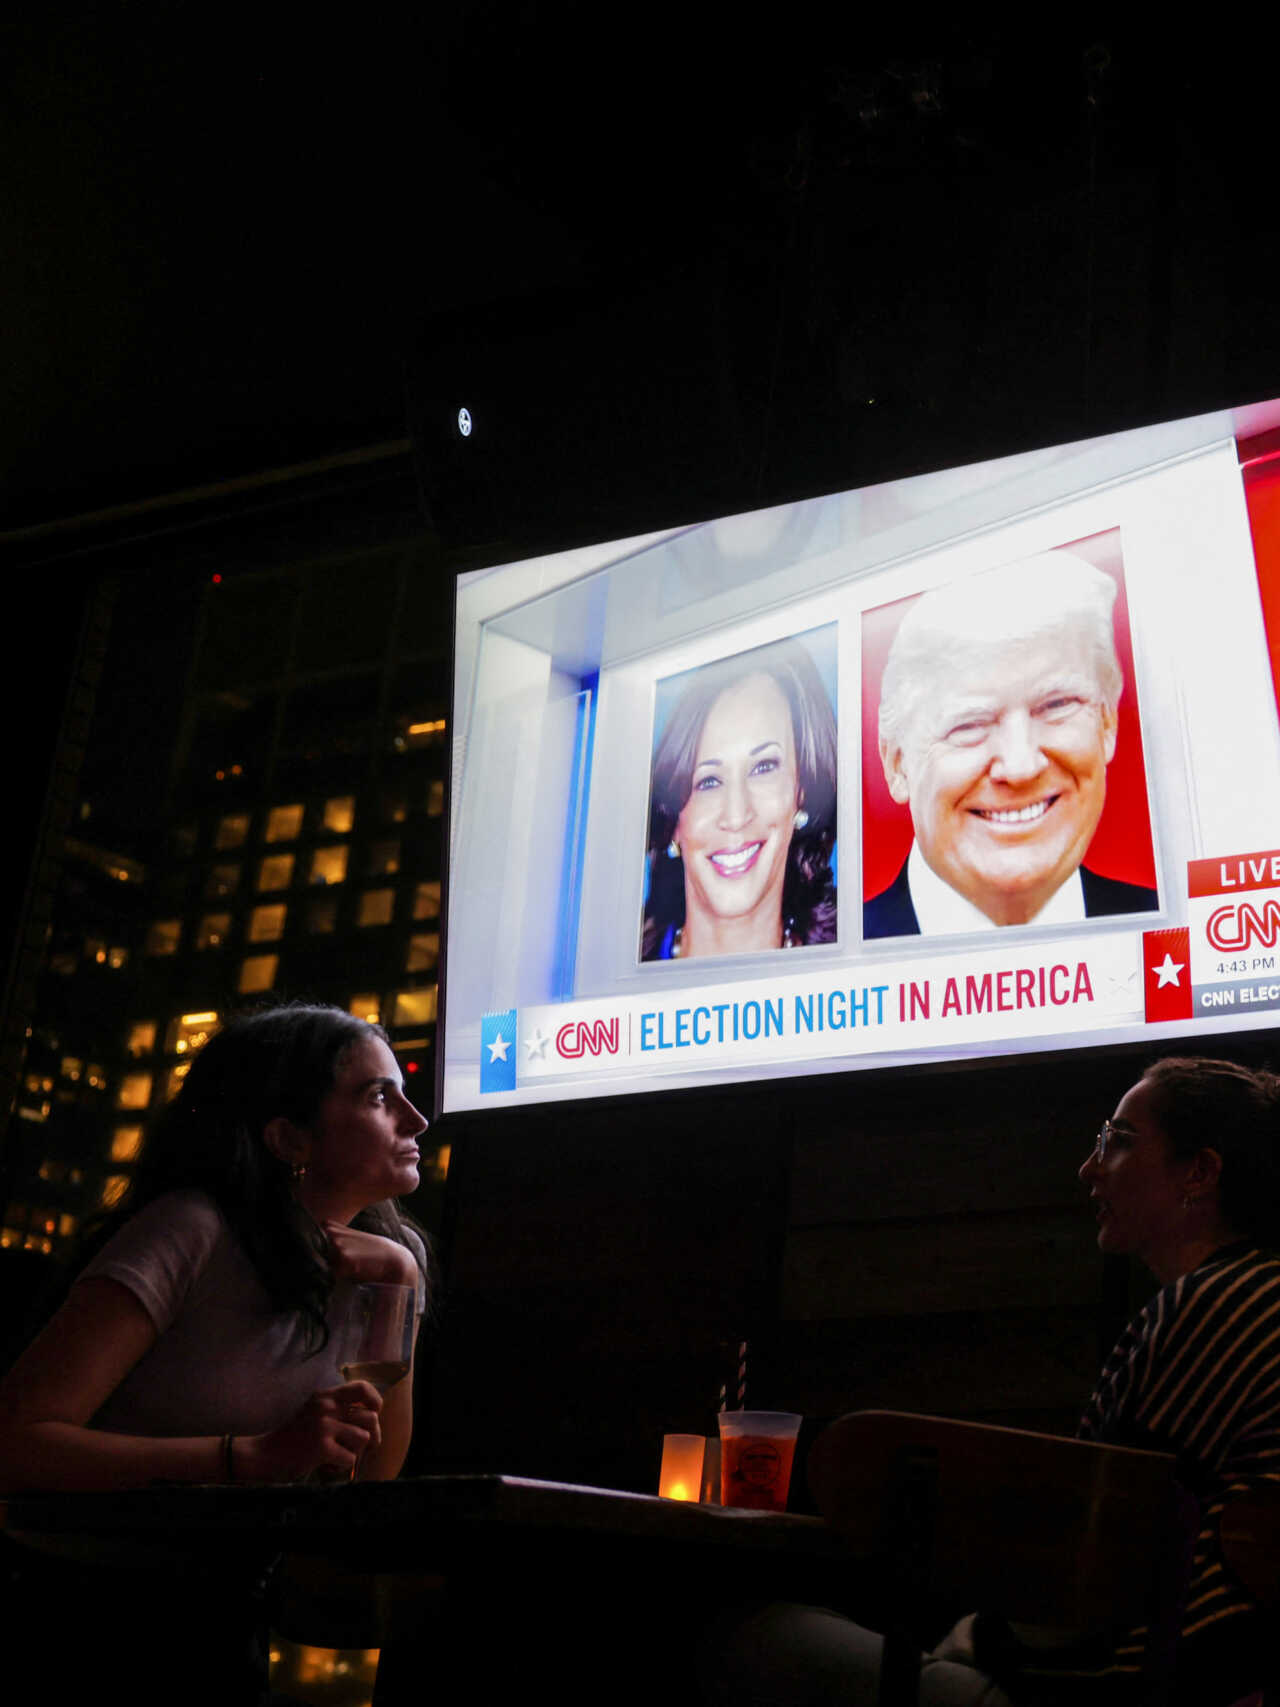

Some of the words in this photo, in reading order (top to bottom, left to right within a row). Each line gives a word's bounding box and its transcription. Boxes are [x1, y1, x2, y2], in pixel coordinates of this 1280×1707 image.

[1217, 960, 1247, 974] 4:43
[1252, 957, 1275, 971] PM
[1201, 989, 1235, 1007] CNN
[556, 1017, 619, 1059] CNN
[641, 997, 784, 1051] ELECTION
[795, 985, 889, 1034] NIGHT
[899, 980, 930, 1022] IN
[941, 962, 1095, 1018] AMERICA
